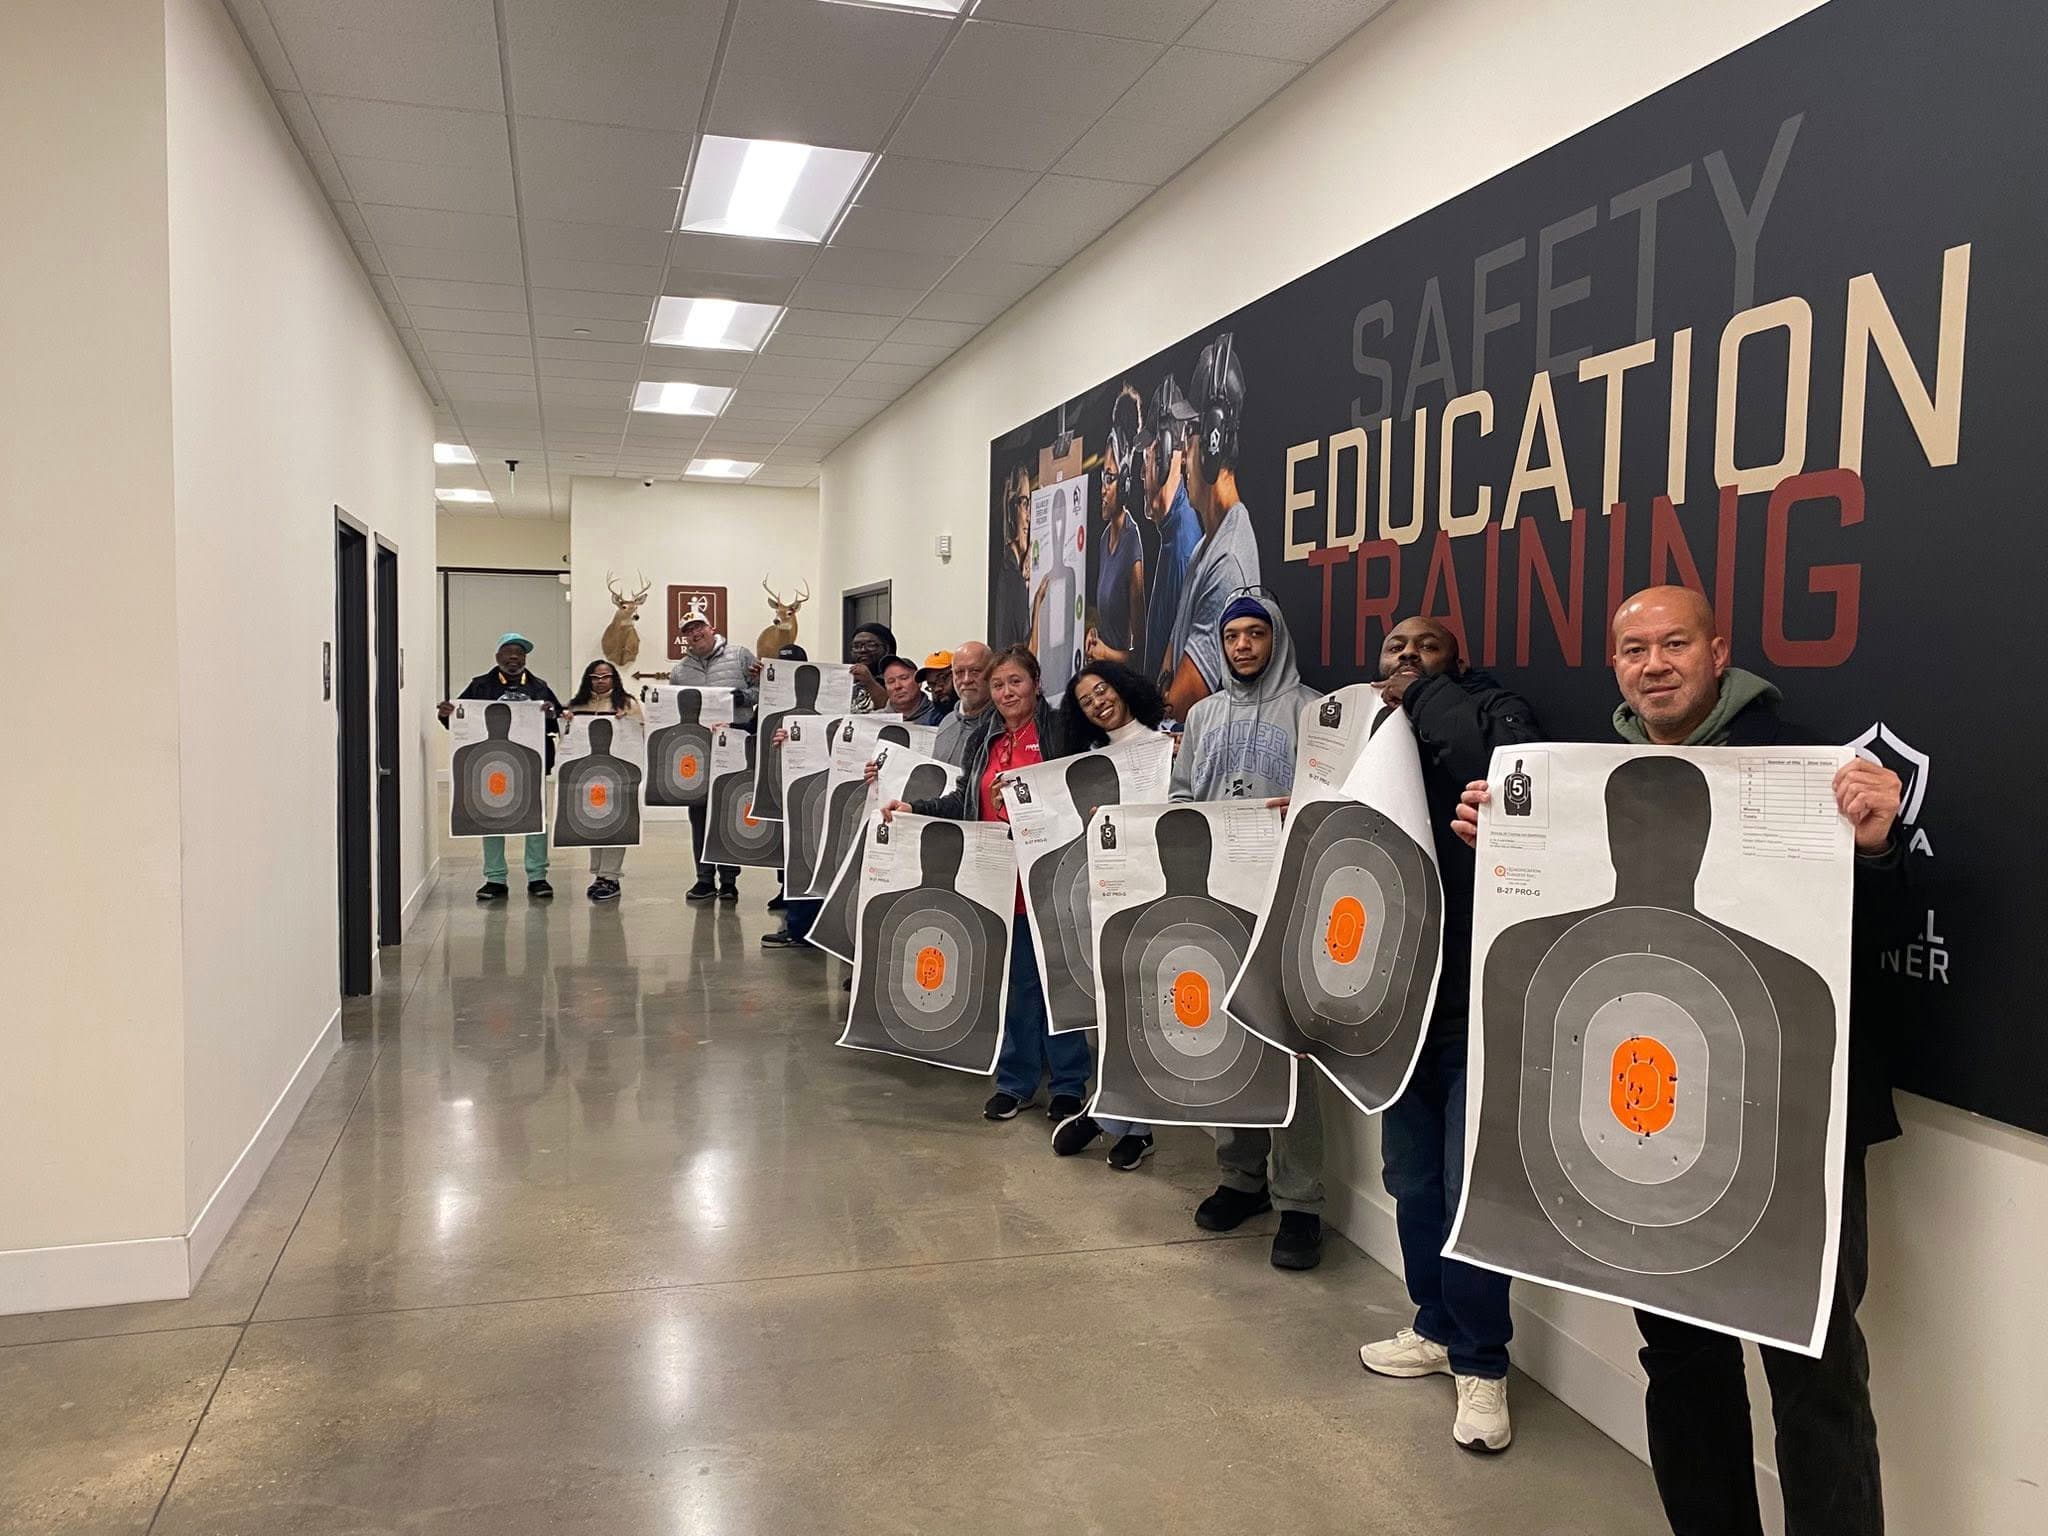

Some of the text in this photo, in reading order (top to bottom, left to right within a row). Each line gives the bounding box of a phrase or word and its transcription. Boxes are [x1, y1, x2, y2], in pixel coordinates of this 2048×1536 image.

[1351, 112, 1803, 432] SAFETY
[1284, 243, 1971, 561] EDUCATION
[1308, 468, 1865, 668] TRAINING
[1326, 704, 1335, 715] 5
[1019, 787, 1026, 795] 5
[1512, 780, 1523, 796] 5
[1105, 827, 1112, 839] 5
[1909, 828, 1934, 857] A
[1496, 886, 1541, 897] B-27 PRO-G
[1880, 943, 1950, 985] NER
